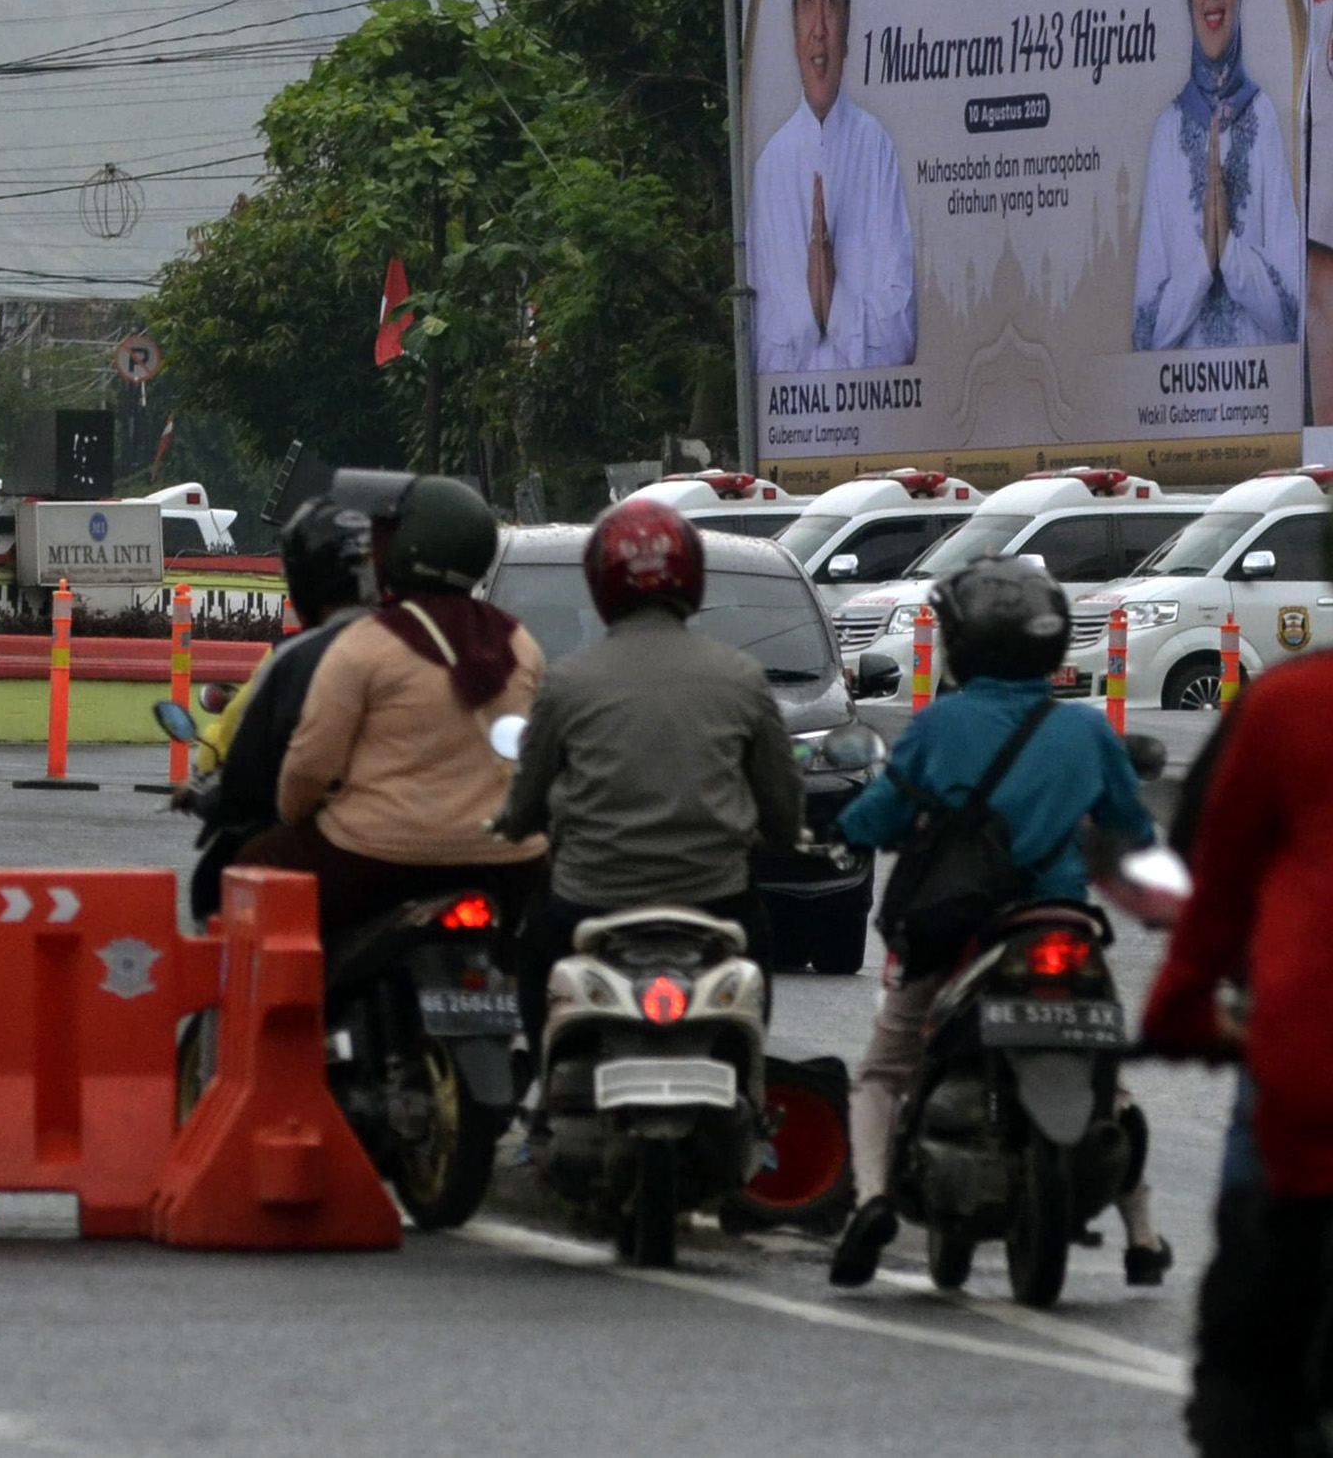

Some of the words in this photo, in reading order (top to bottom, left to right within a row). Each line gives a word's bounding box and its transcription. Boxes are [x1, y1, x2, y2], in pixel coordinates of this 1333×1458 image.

[880, 26, 1004, 84] Muharram
[1009, 11, 1064, 73] 1443
[1070, 7, 1156, 85] Hijriah
[968, 105, 979, 123] 10
[981, 102, 1023, 127] Agustus
[1024, 99, 1047, 119] 2021
[917, 151, 992, 184] Muhasabah
[995, 152, 1020, 178] dan
[1023, 144, 1101, 181] muraqobah
[948, 188, 998, 215] ditahun
[1001, 189, 1034, 219] yang
[1038, 183, 1069, 208] baru
[1160, 359, 1269, 394] CHUSNUNIA
[768, 384, 830, 415] ARINAL
[836, 378, 922, 412] DJUNAIDI
[1137, 403, 1167, 426] Wakil
[1170, 403, 1217, 423] Gubernur
[1220, 403, 1269, 426] Lampung
[768, 426, 812, 444] Gubernur
[815, 425, 859, 446] Lampung
[48, 545, 107, 564] MITRA
[113, 545, 152, 563] INTI
